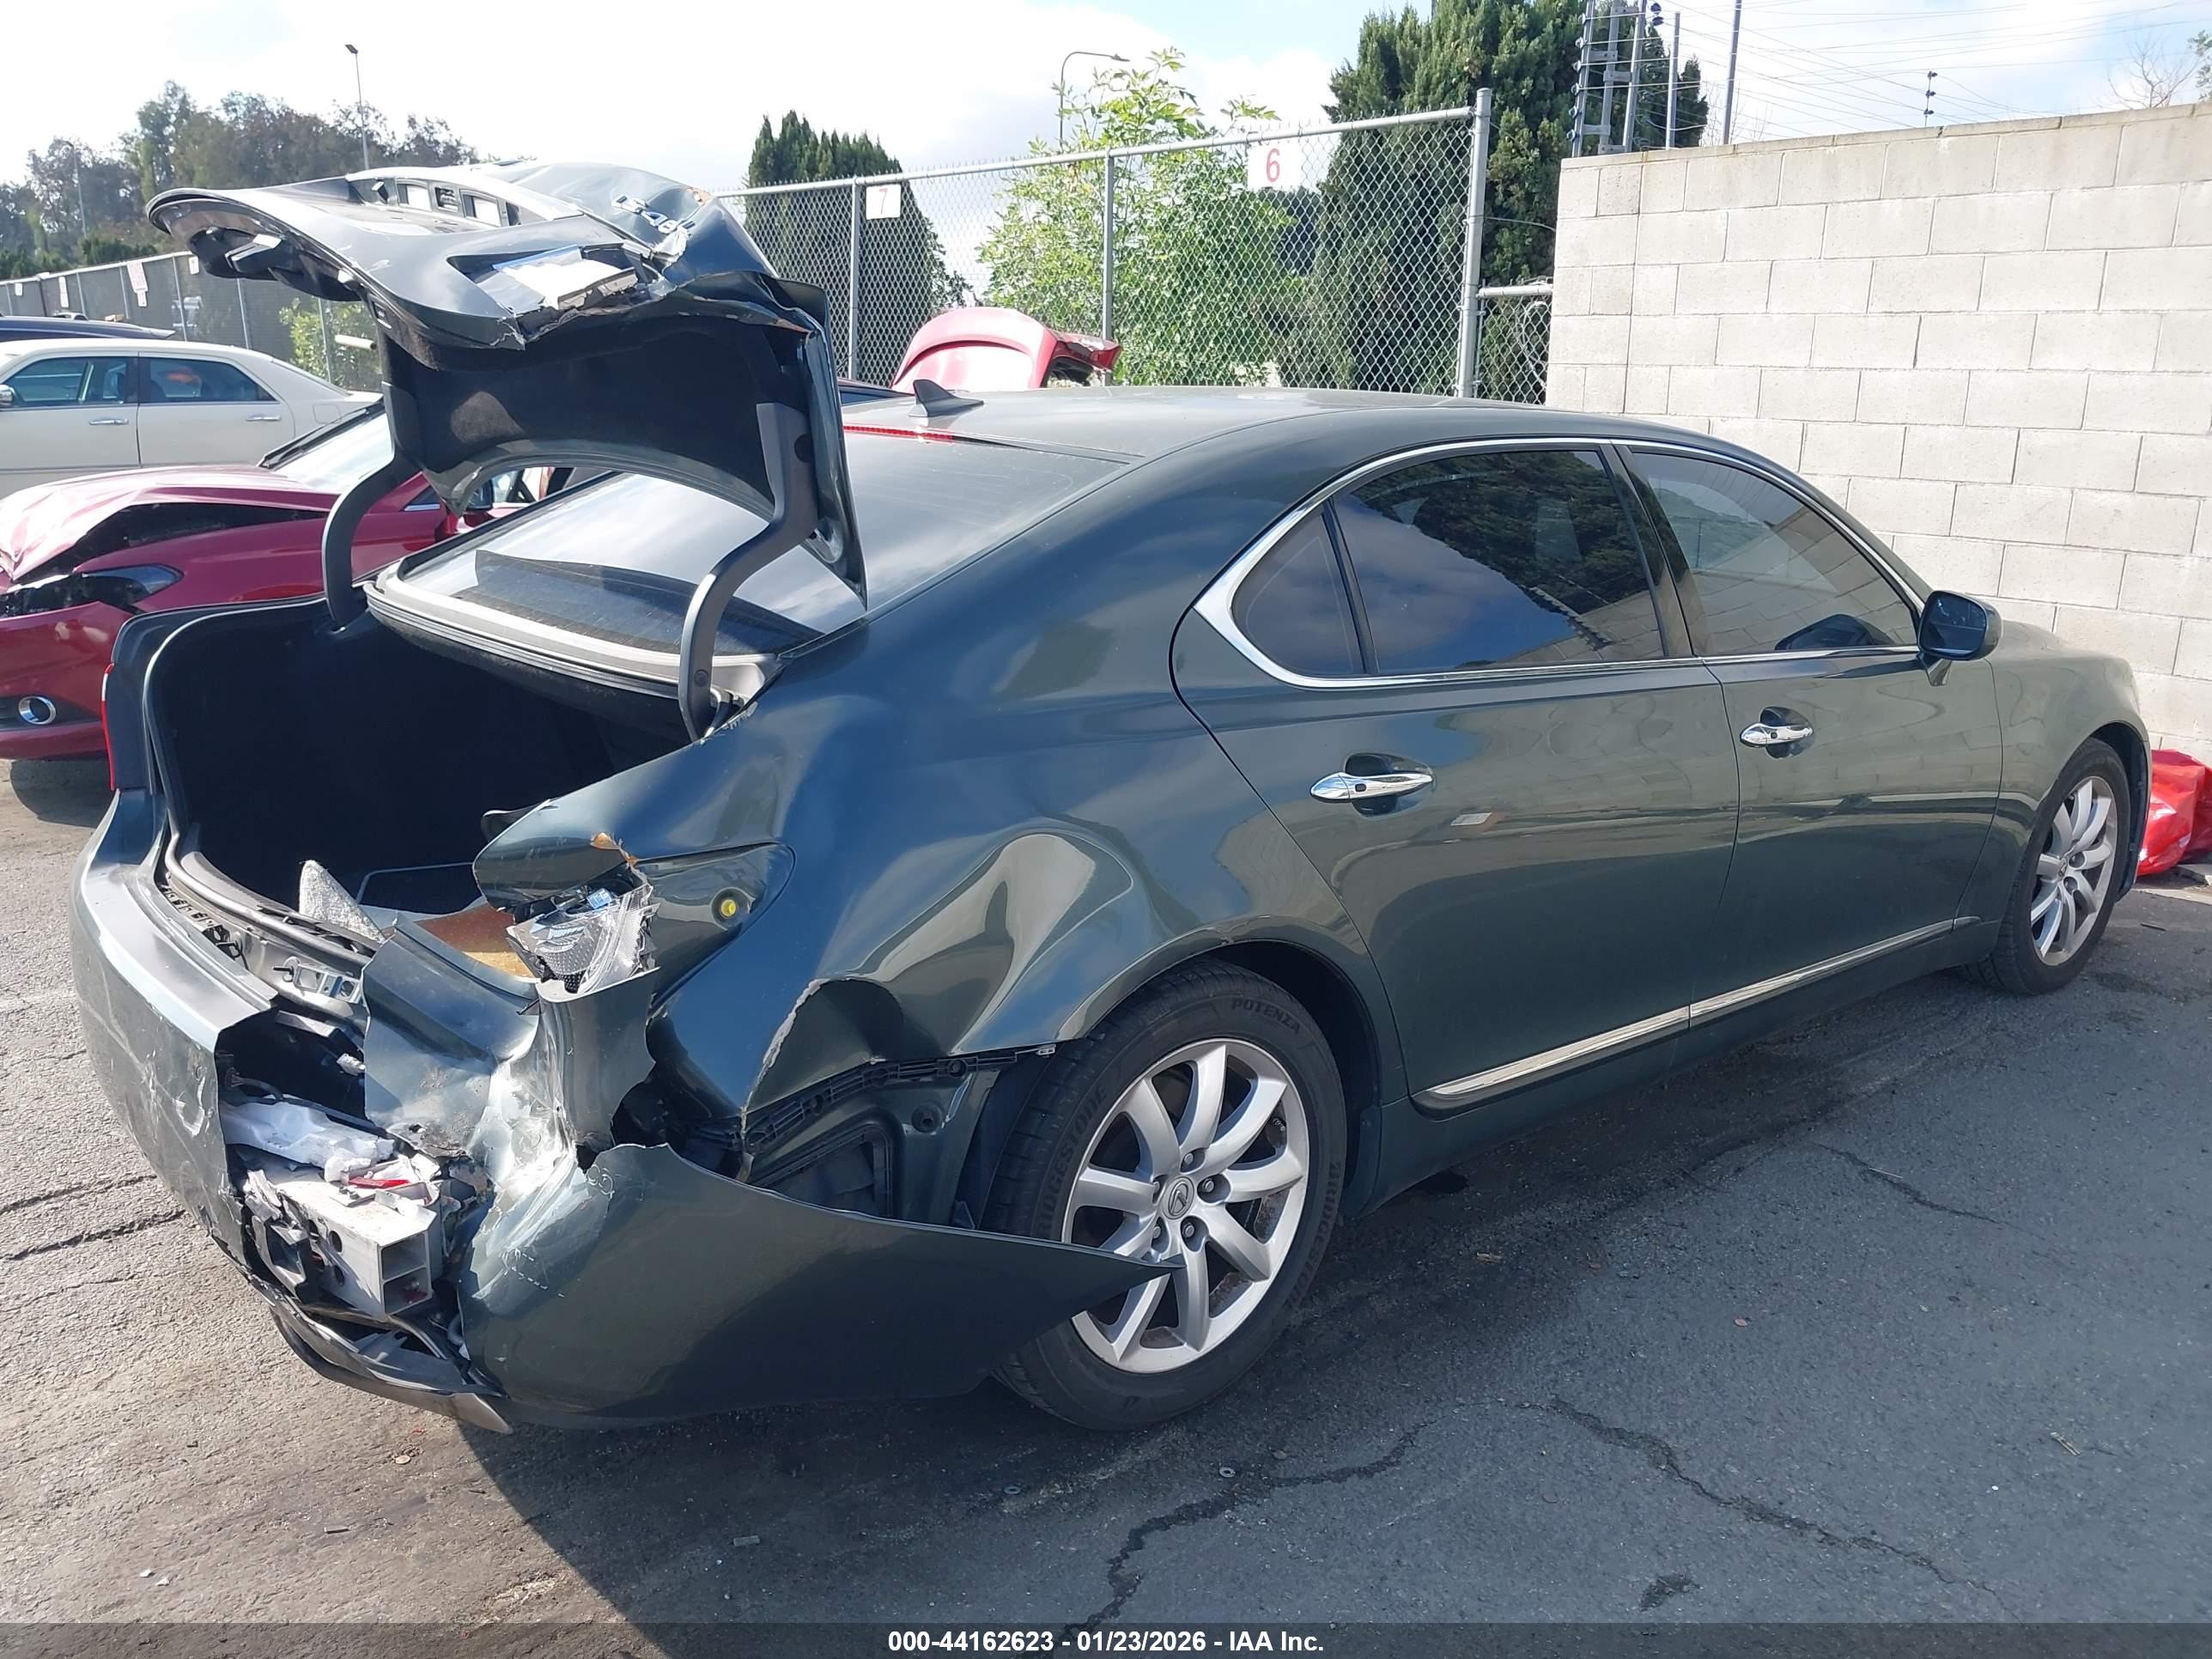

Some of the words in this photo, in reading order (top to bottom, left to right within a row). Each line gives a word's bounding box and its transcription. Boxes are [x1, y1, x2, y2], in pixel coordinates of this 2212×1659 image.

[1266, 148, 1280, 183] 6
[878, 187, 888, 216] 7
[1231, 997, 1301, 1035] POTENZA
[1034, 1082, 1108, 1239] RIDGESTONE
